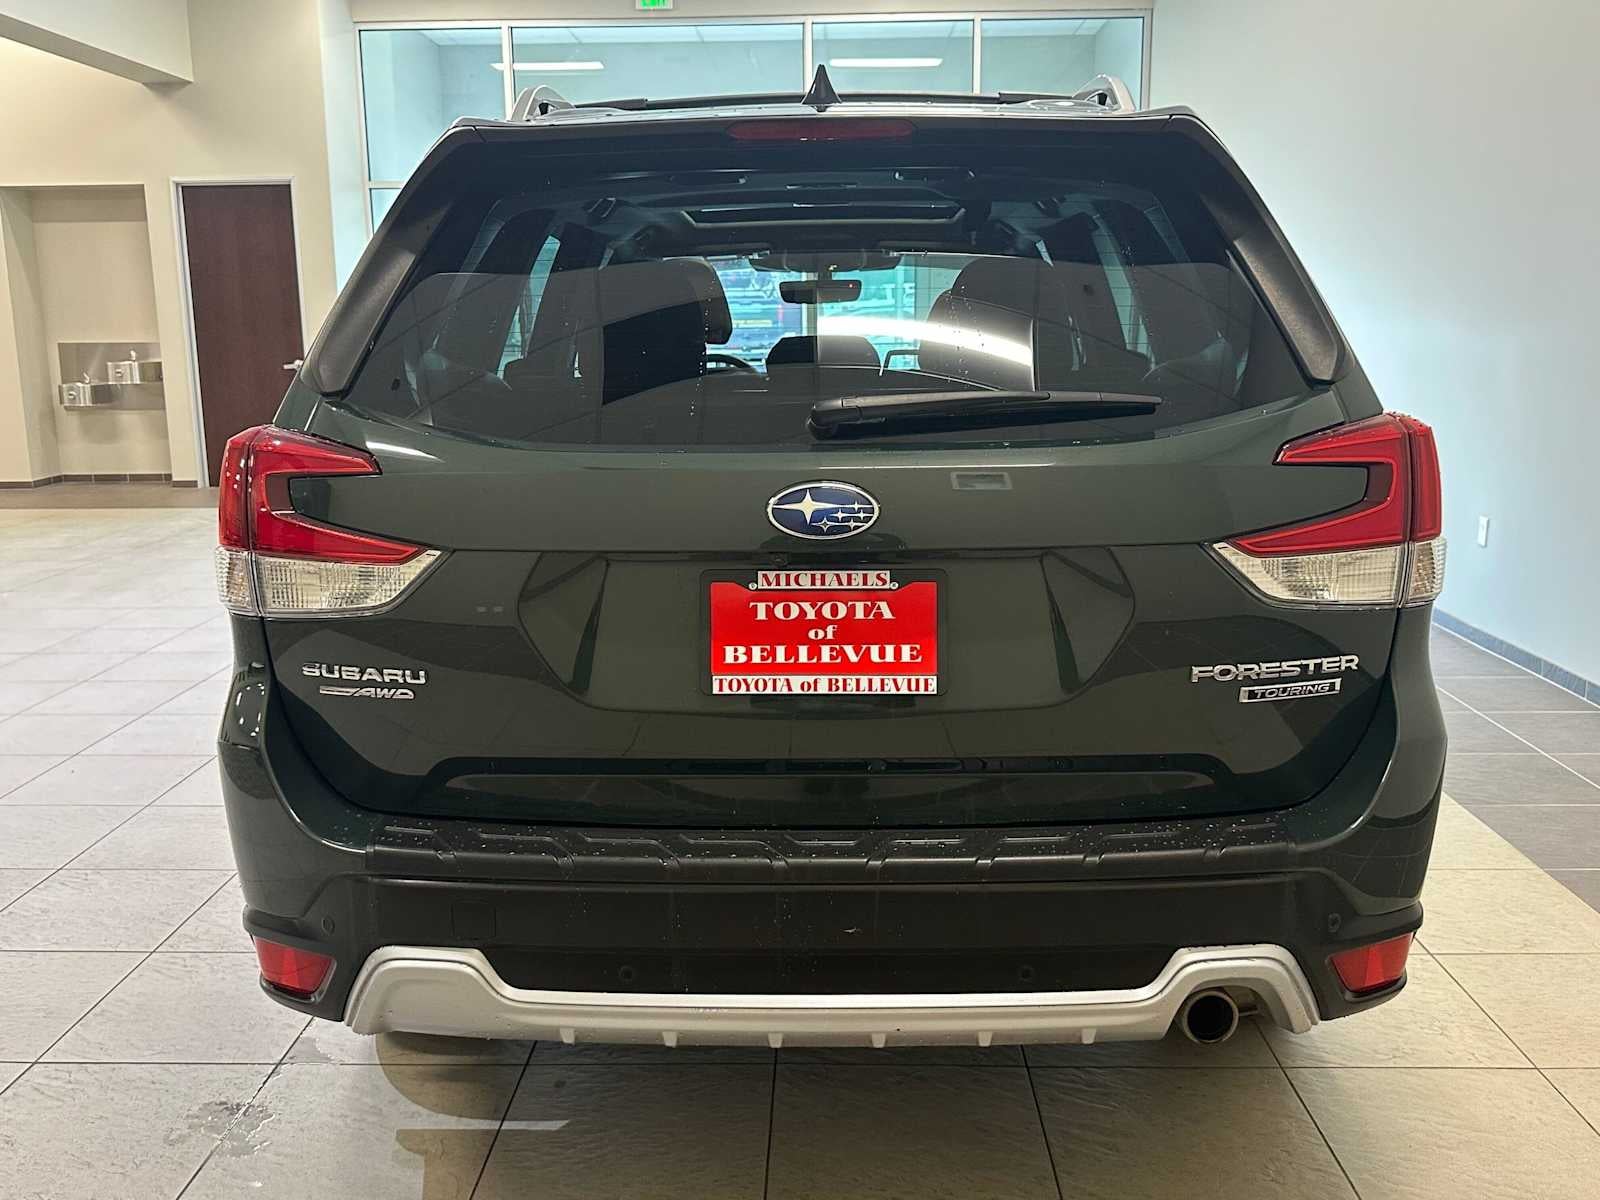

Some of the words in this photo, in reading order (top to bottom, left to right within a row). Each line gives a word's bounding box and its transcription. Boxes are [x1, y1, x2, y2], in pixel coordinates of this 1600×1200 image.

[761, 573, 888, 587] MICHAELS
[749, 601, 896, 620] TOYOTA
[808, 624, 838, 640] of
[723, 644, 923, 664] BELLEVUE
[302, 662, 426, 685] SUBARU
[1191, 654, 1360, 683] FORESTER
[714, 677, 793, 692] TOYOTA
[800, 677, 821, 692] of
[828, 677, 935, 692] BELLEVUE
[1254, 683, 1330, 699] TOURING
[352, 687, 416, 700] AWD
